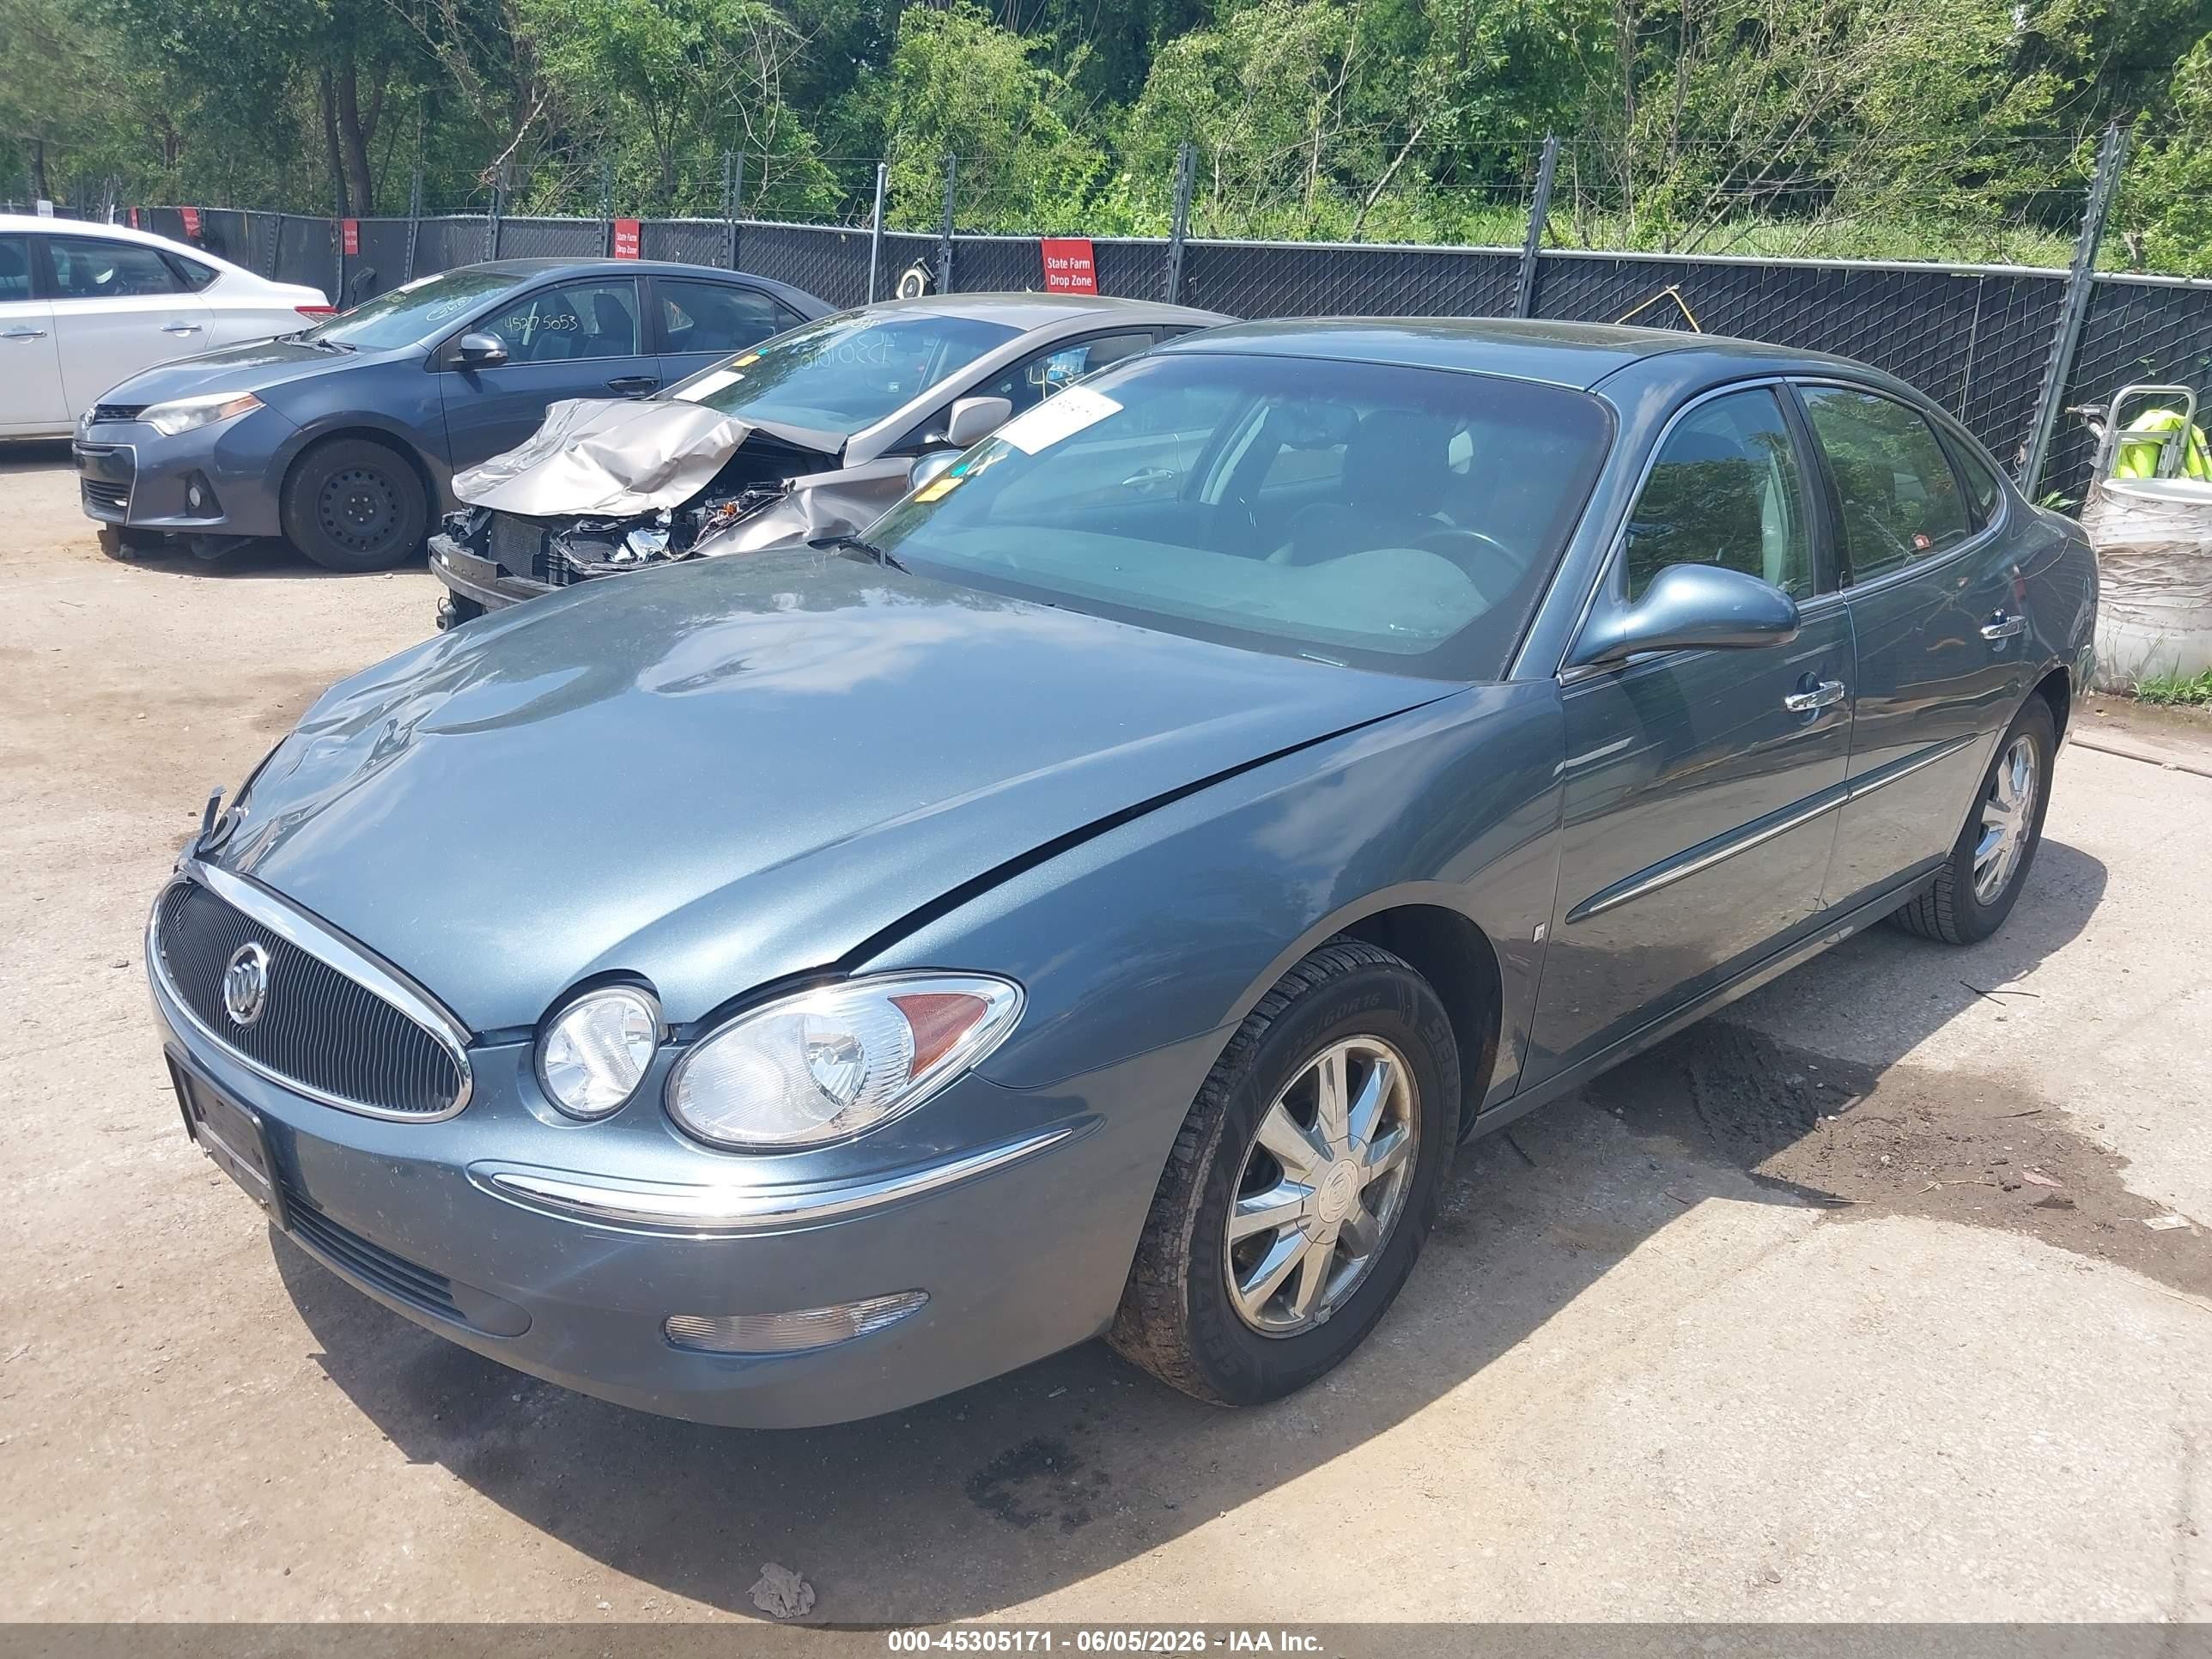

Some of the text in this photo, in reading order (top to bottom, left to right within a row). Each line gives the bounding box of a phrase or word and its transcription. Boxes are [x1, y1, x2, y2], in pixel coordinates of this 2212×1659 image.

[1048, 258, 1091, 270] State Farm
[1050, 275, 1092, 289] Drop Zone
